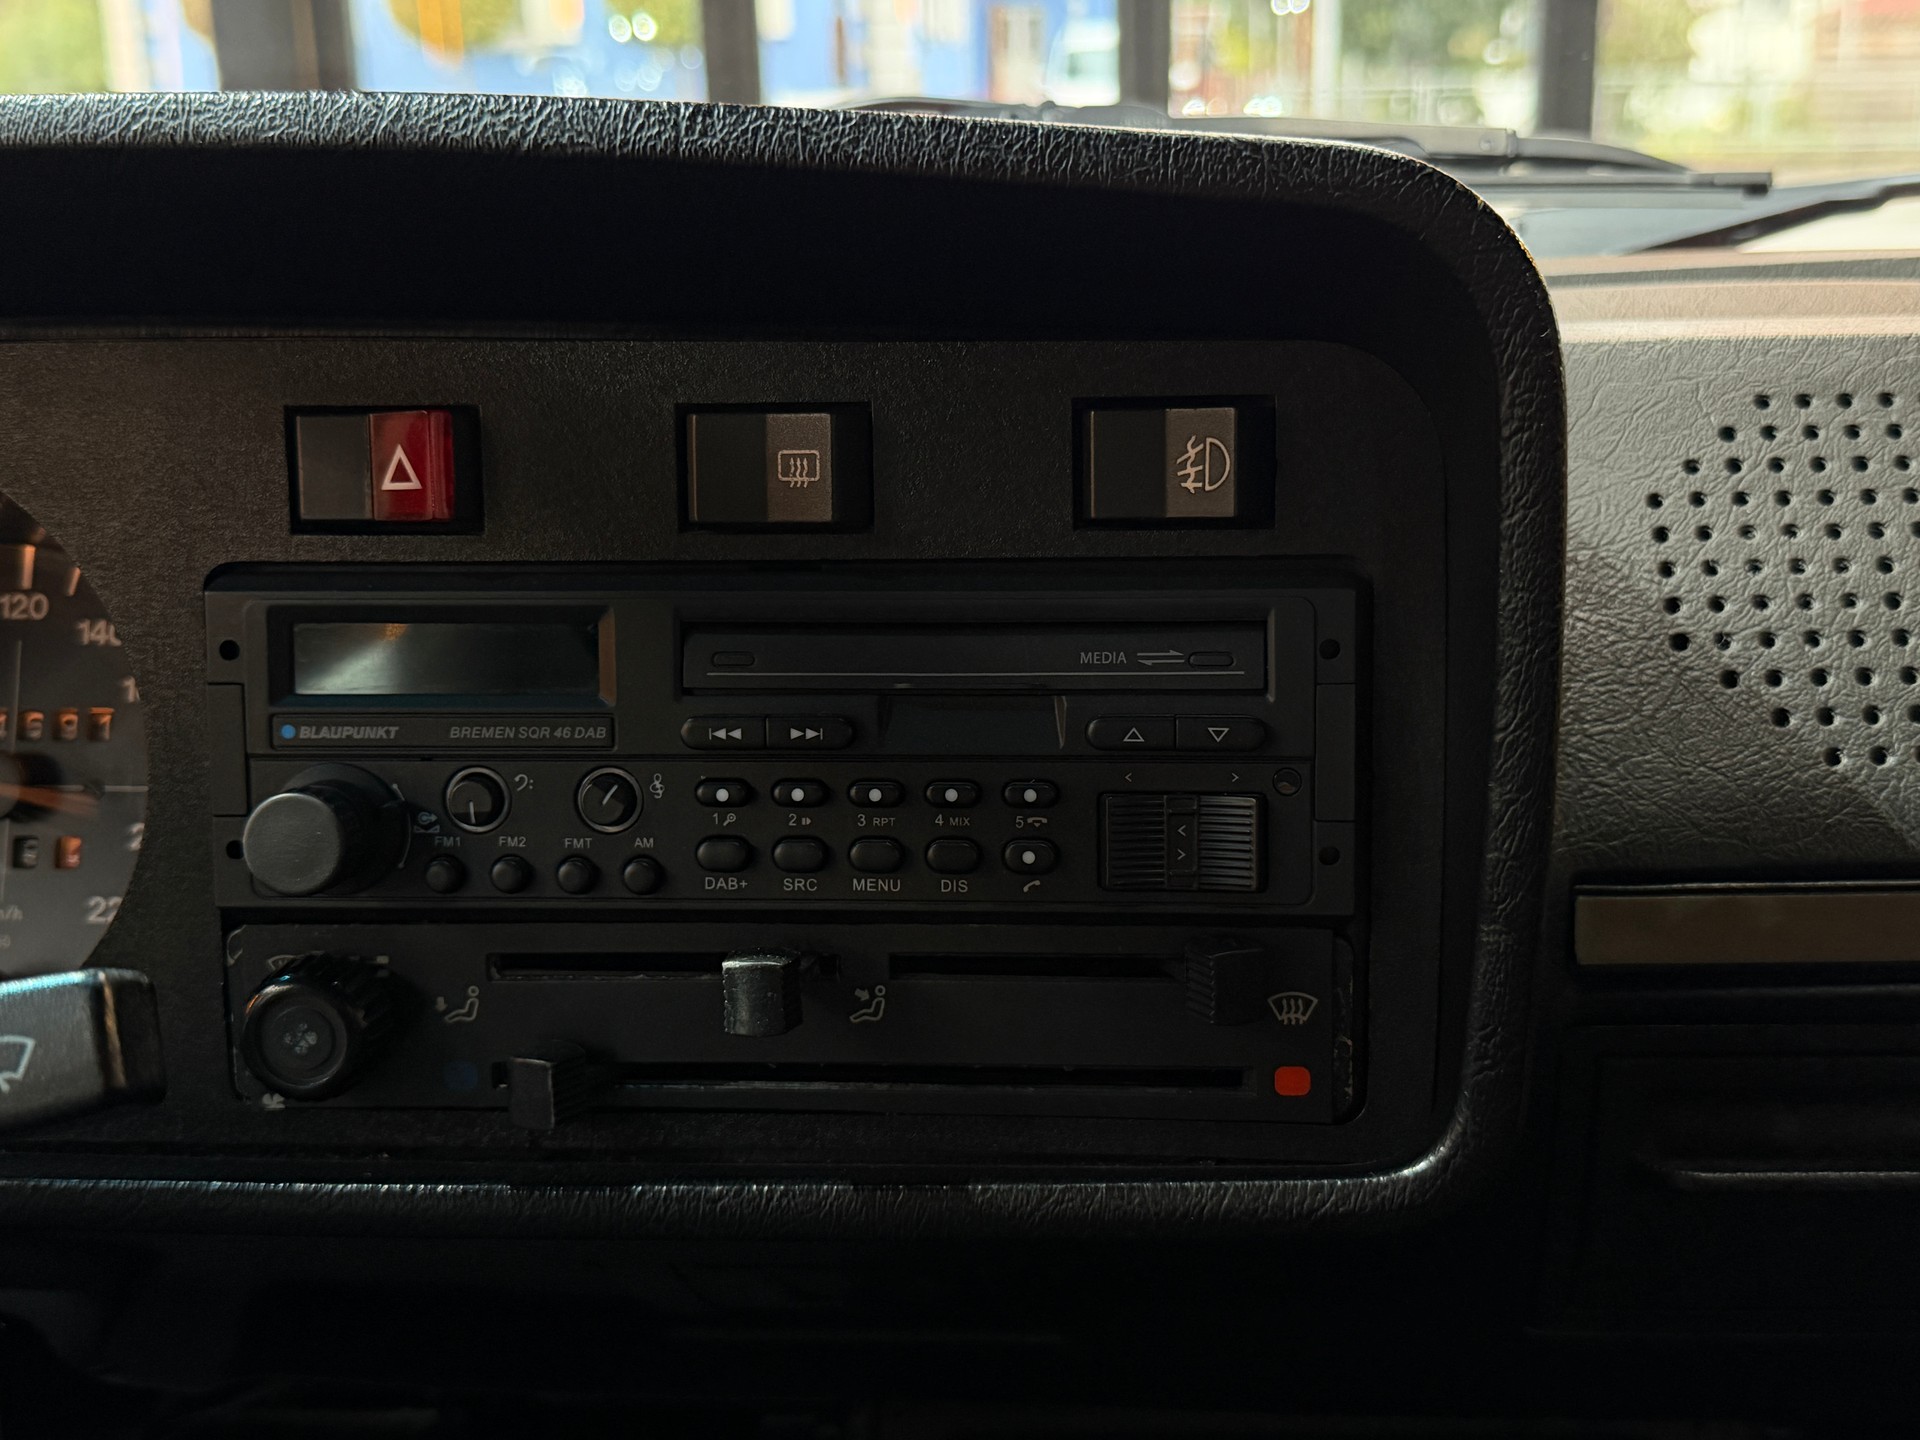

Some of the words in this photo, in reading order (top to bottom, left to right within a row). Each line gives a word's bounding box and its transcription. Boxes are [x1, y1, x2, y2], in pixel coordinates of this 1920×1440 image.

[0, 592, 50, 620] 120
[1080, 652, 1127, 664] MEDIA
[299, 726, 400, 739] BLAUPUNKT
[449, 726, 516, 739] BREMEN
[553, 726, 572, 739] 46
[574, 726, 607, 739] DAB
[711, 813, 719, 825] 1
[788, 813, 798, 826] 2
[857, 814, 867, 827] 3
[872, 817, 896, 827] RPT
[934, 814, 945, 827] 4
[949, 817, 971, 827] MIX
[1015, 815, 1024, 829] 5
[434, 836, 461, 848] FM1
[498, 836, 527, 848] FM2
[564, 837, 593, 849] FMT
[634, 837, 654, 849] AM
[704, 877, 748, 890] DAB+
[783, 877, 818, 891] SRC
[852, 878, 901, 892] MENU
[940, 879, 969, 893] DIS
